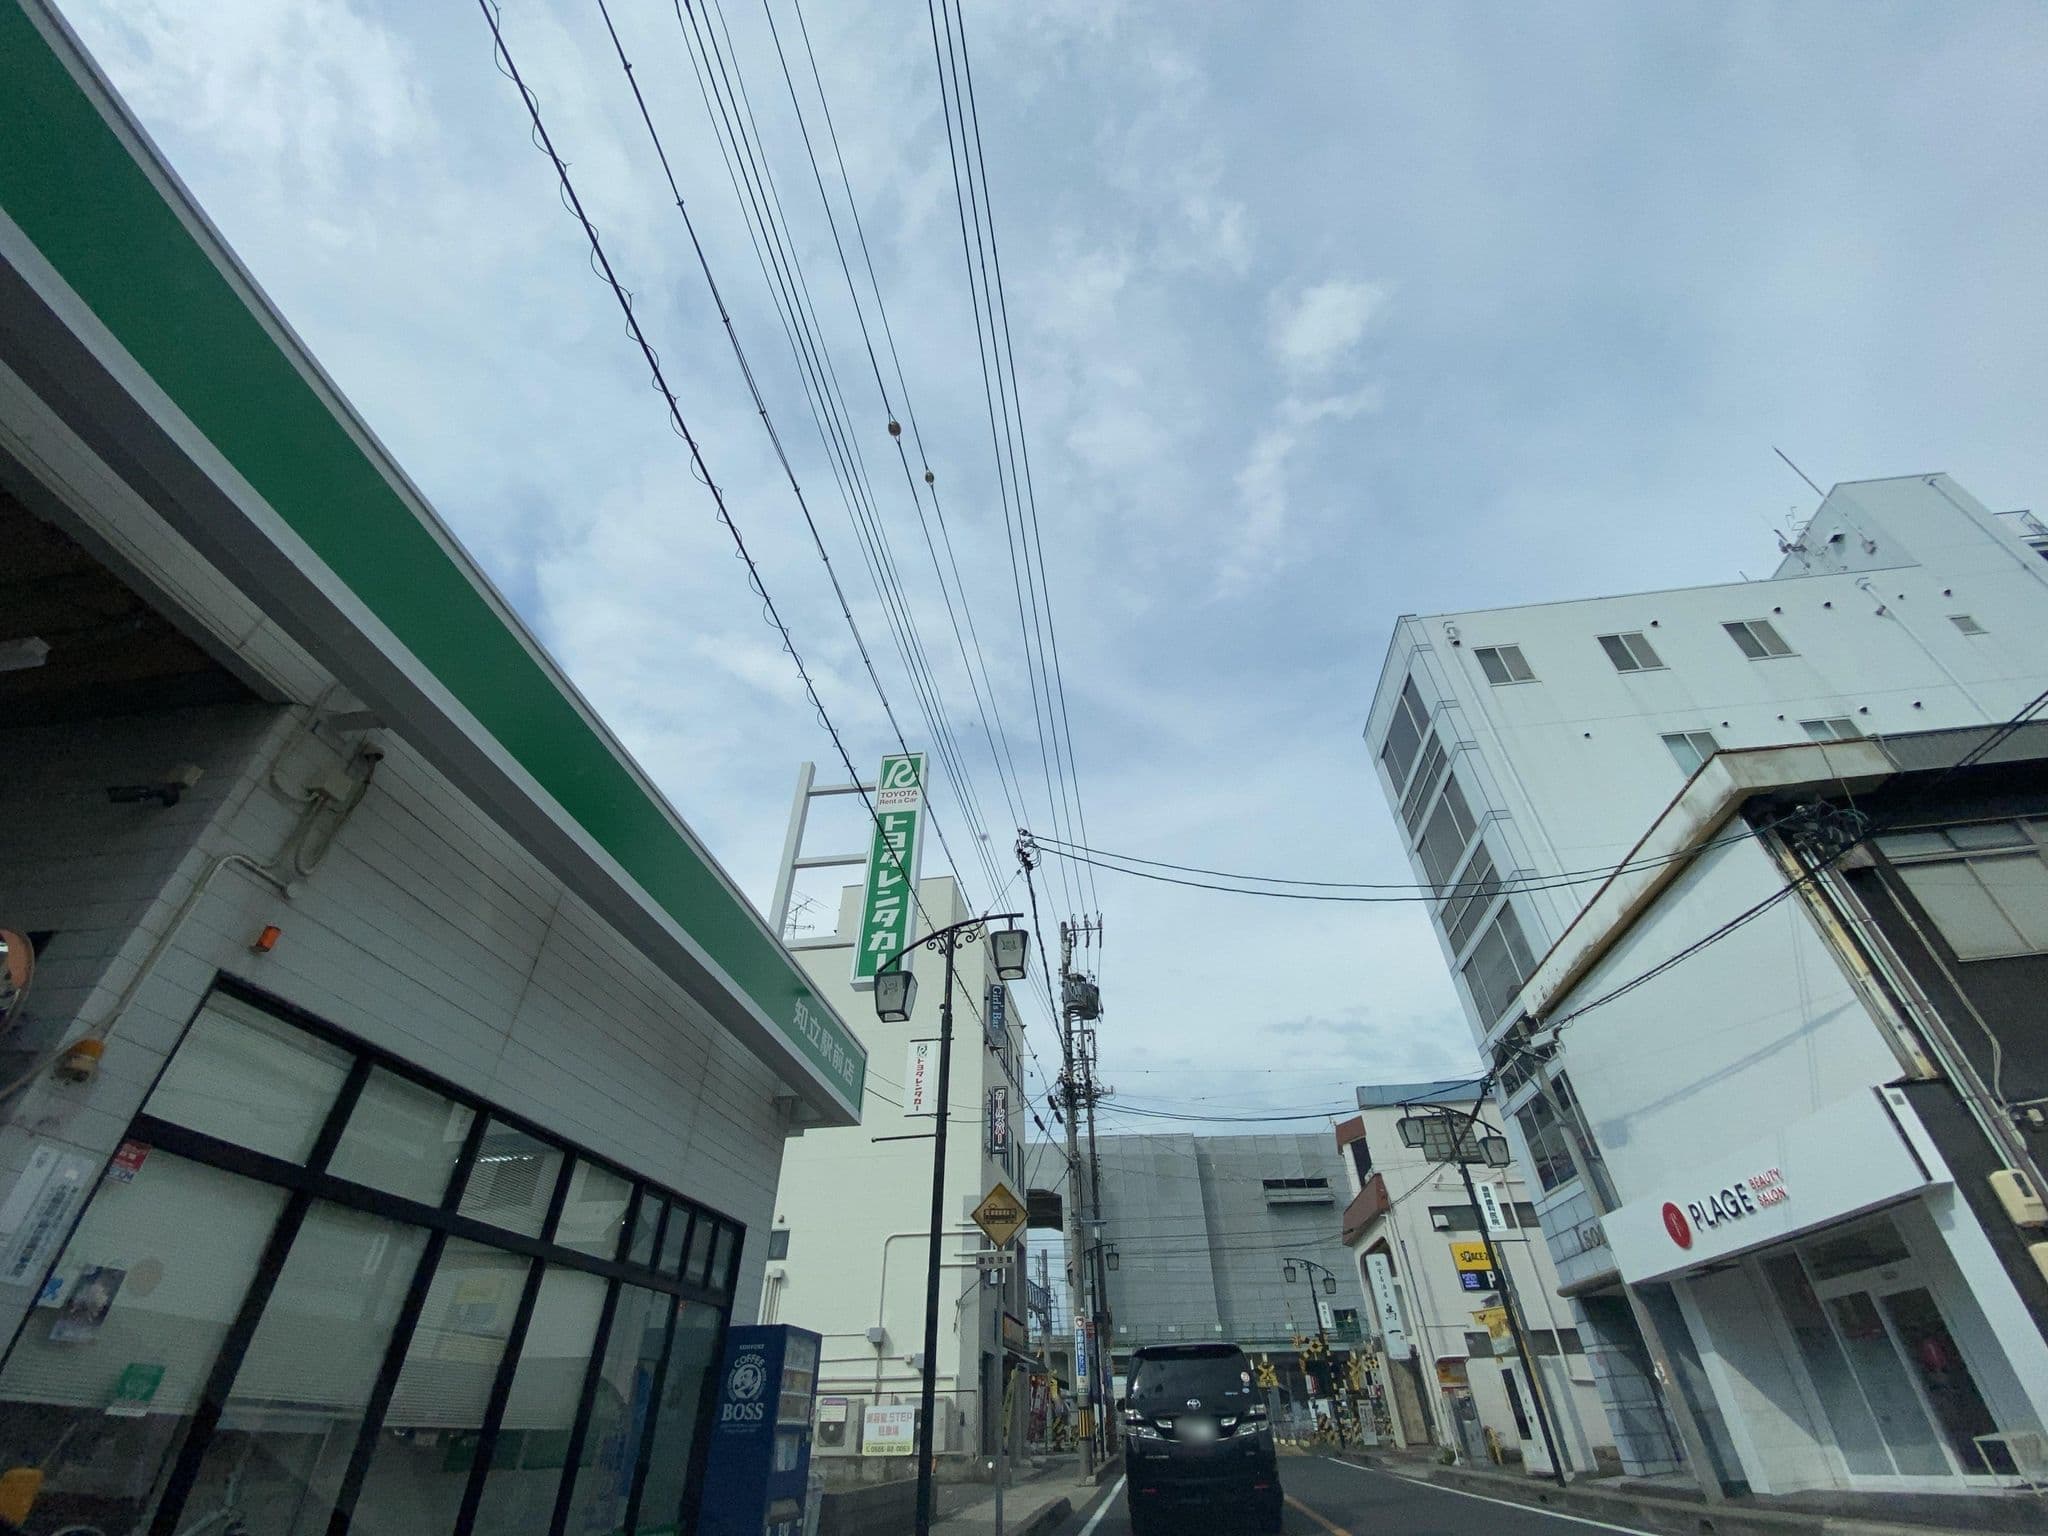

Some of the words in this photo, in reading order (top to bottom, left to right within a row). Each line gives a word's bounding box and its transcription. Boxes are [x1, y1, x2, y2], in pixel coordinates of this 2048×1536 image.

[880, 790, 918, 799] TOYOTA
[868, 815, 908, 971] トヨタレンタカー
[992, 1012, 1002, 1029] Bar
[792, 997, 855, 1087] 知立駅前店
[913, 1058, 925, 1112] トヨタレンタカー
[995, 1089, 1006, 1145] ガールズバー
[1748, 1167, 1783, 1191] BEAUTY
[1687, 1183, 1755, 1231] PLAGE
[1757, 1186, 1788, 1208] SALON
[734, 1353, 766, 1368] COFFEE
[720, 1402, 765, 1422] BOSS
